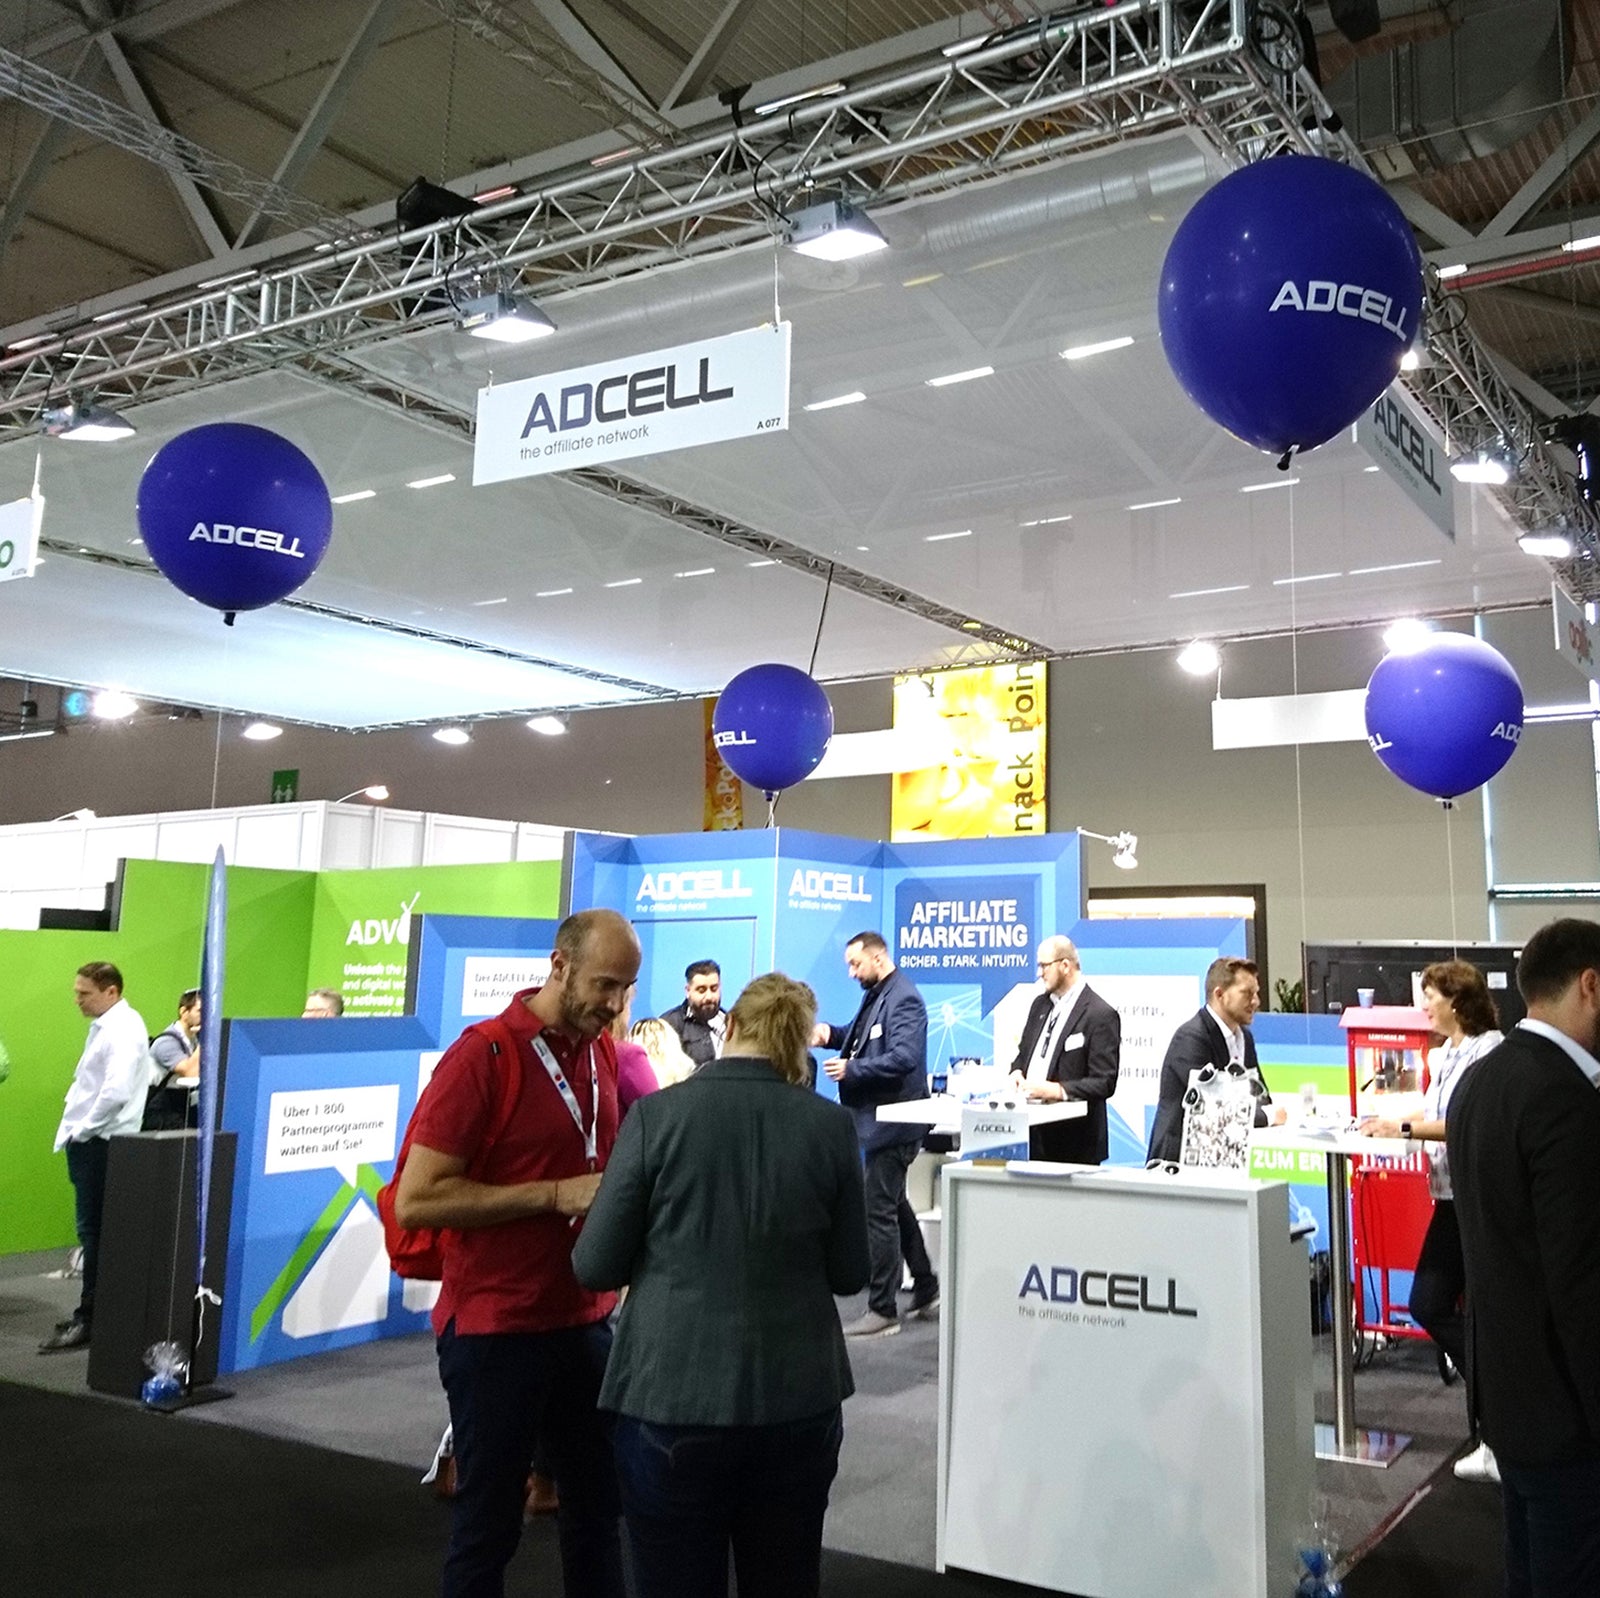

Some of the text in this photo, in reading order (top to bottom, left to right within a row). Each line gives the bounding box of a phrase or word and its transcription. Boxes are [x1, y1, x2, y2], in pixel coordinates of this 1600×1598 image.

[1269, 280, 1407, 341] ADCELL
[520, 357, 734, 439] ADCELL
[757, 418, 781, 430] A 077
[520, 424, 649, 460] the affiliate network
[1374, 397, 1441, 496] ADCELL
[189, 522, 304, 558] ADCELL
[635, 869, 752, 901] ADCELL
[788, 868, 872, 903] ADCELL
[910, 899, 1017, 924] AFFILIATE
[899, 924, 1028, 949] MARKETING
[900, 954, 1029, 968] SICHER. STARK. INTUITIV.
[281, 1120, 384, 1137] Partnerprogramme
[973, 1124, 1016, 1134] ADCELL
[280, 1144, 319, 1157] warten
[321, 1139, 341, 1152] auf
[1253, 1148, 1295, 1170] ZUM
[1018, 1264, 1197, 1317] ADCELL
[1018, 1306, 1127, 1328] the affiliate network
